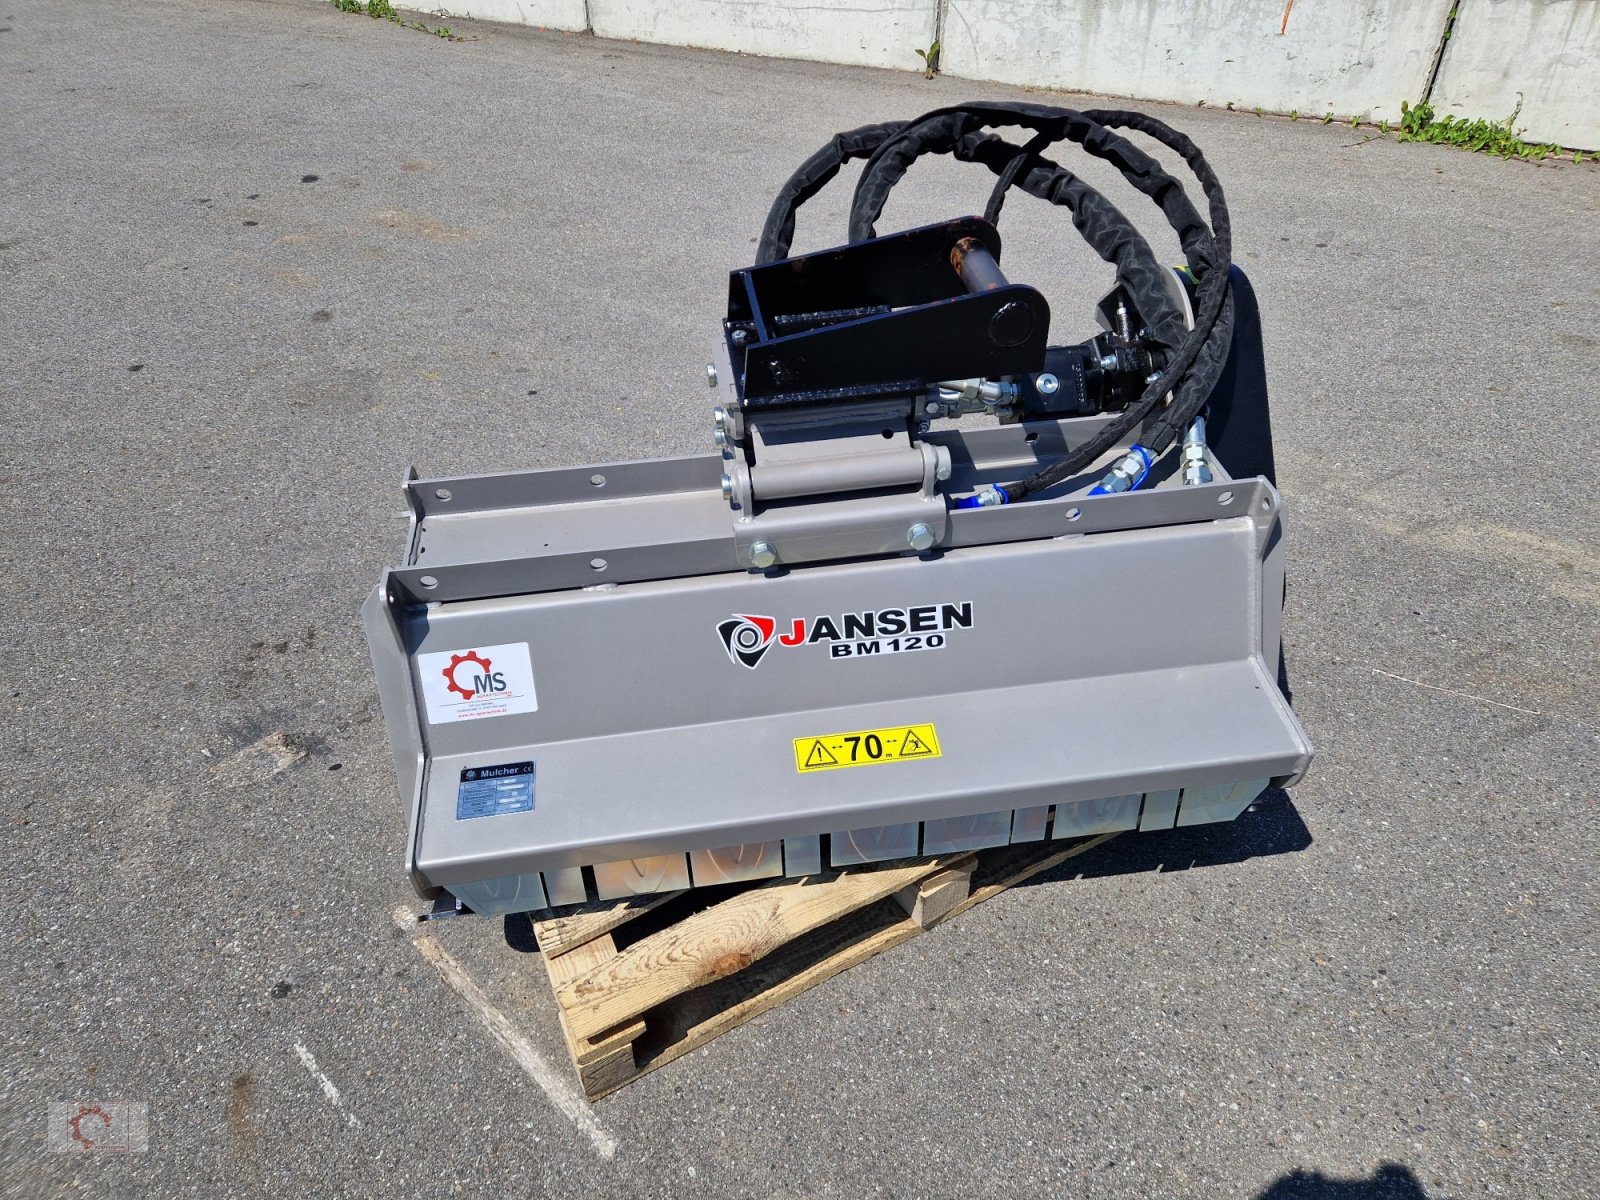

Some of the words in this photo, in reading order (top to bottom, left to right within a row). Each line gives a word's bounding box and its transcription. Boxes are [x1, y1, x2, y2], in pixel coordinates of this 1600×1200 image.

[780, 602, 972, 645] JANSEN
[474, 672, 507, 694] MS
[844, 734, 883, 762] 70
[480, 767, 519, 777] Mulcher
